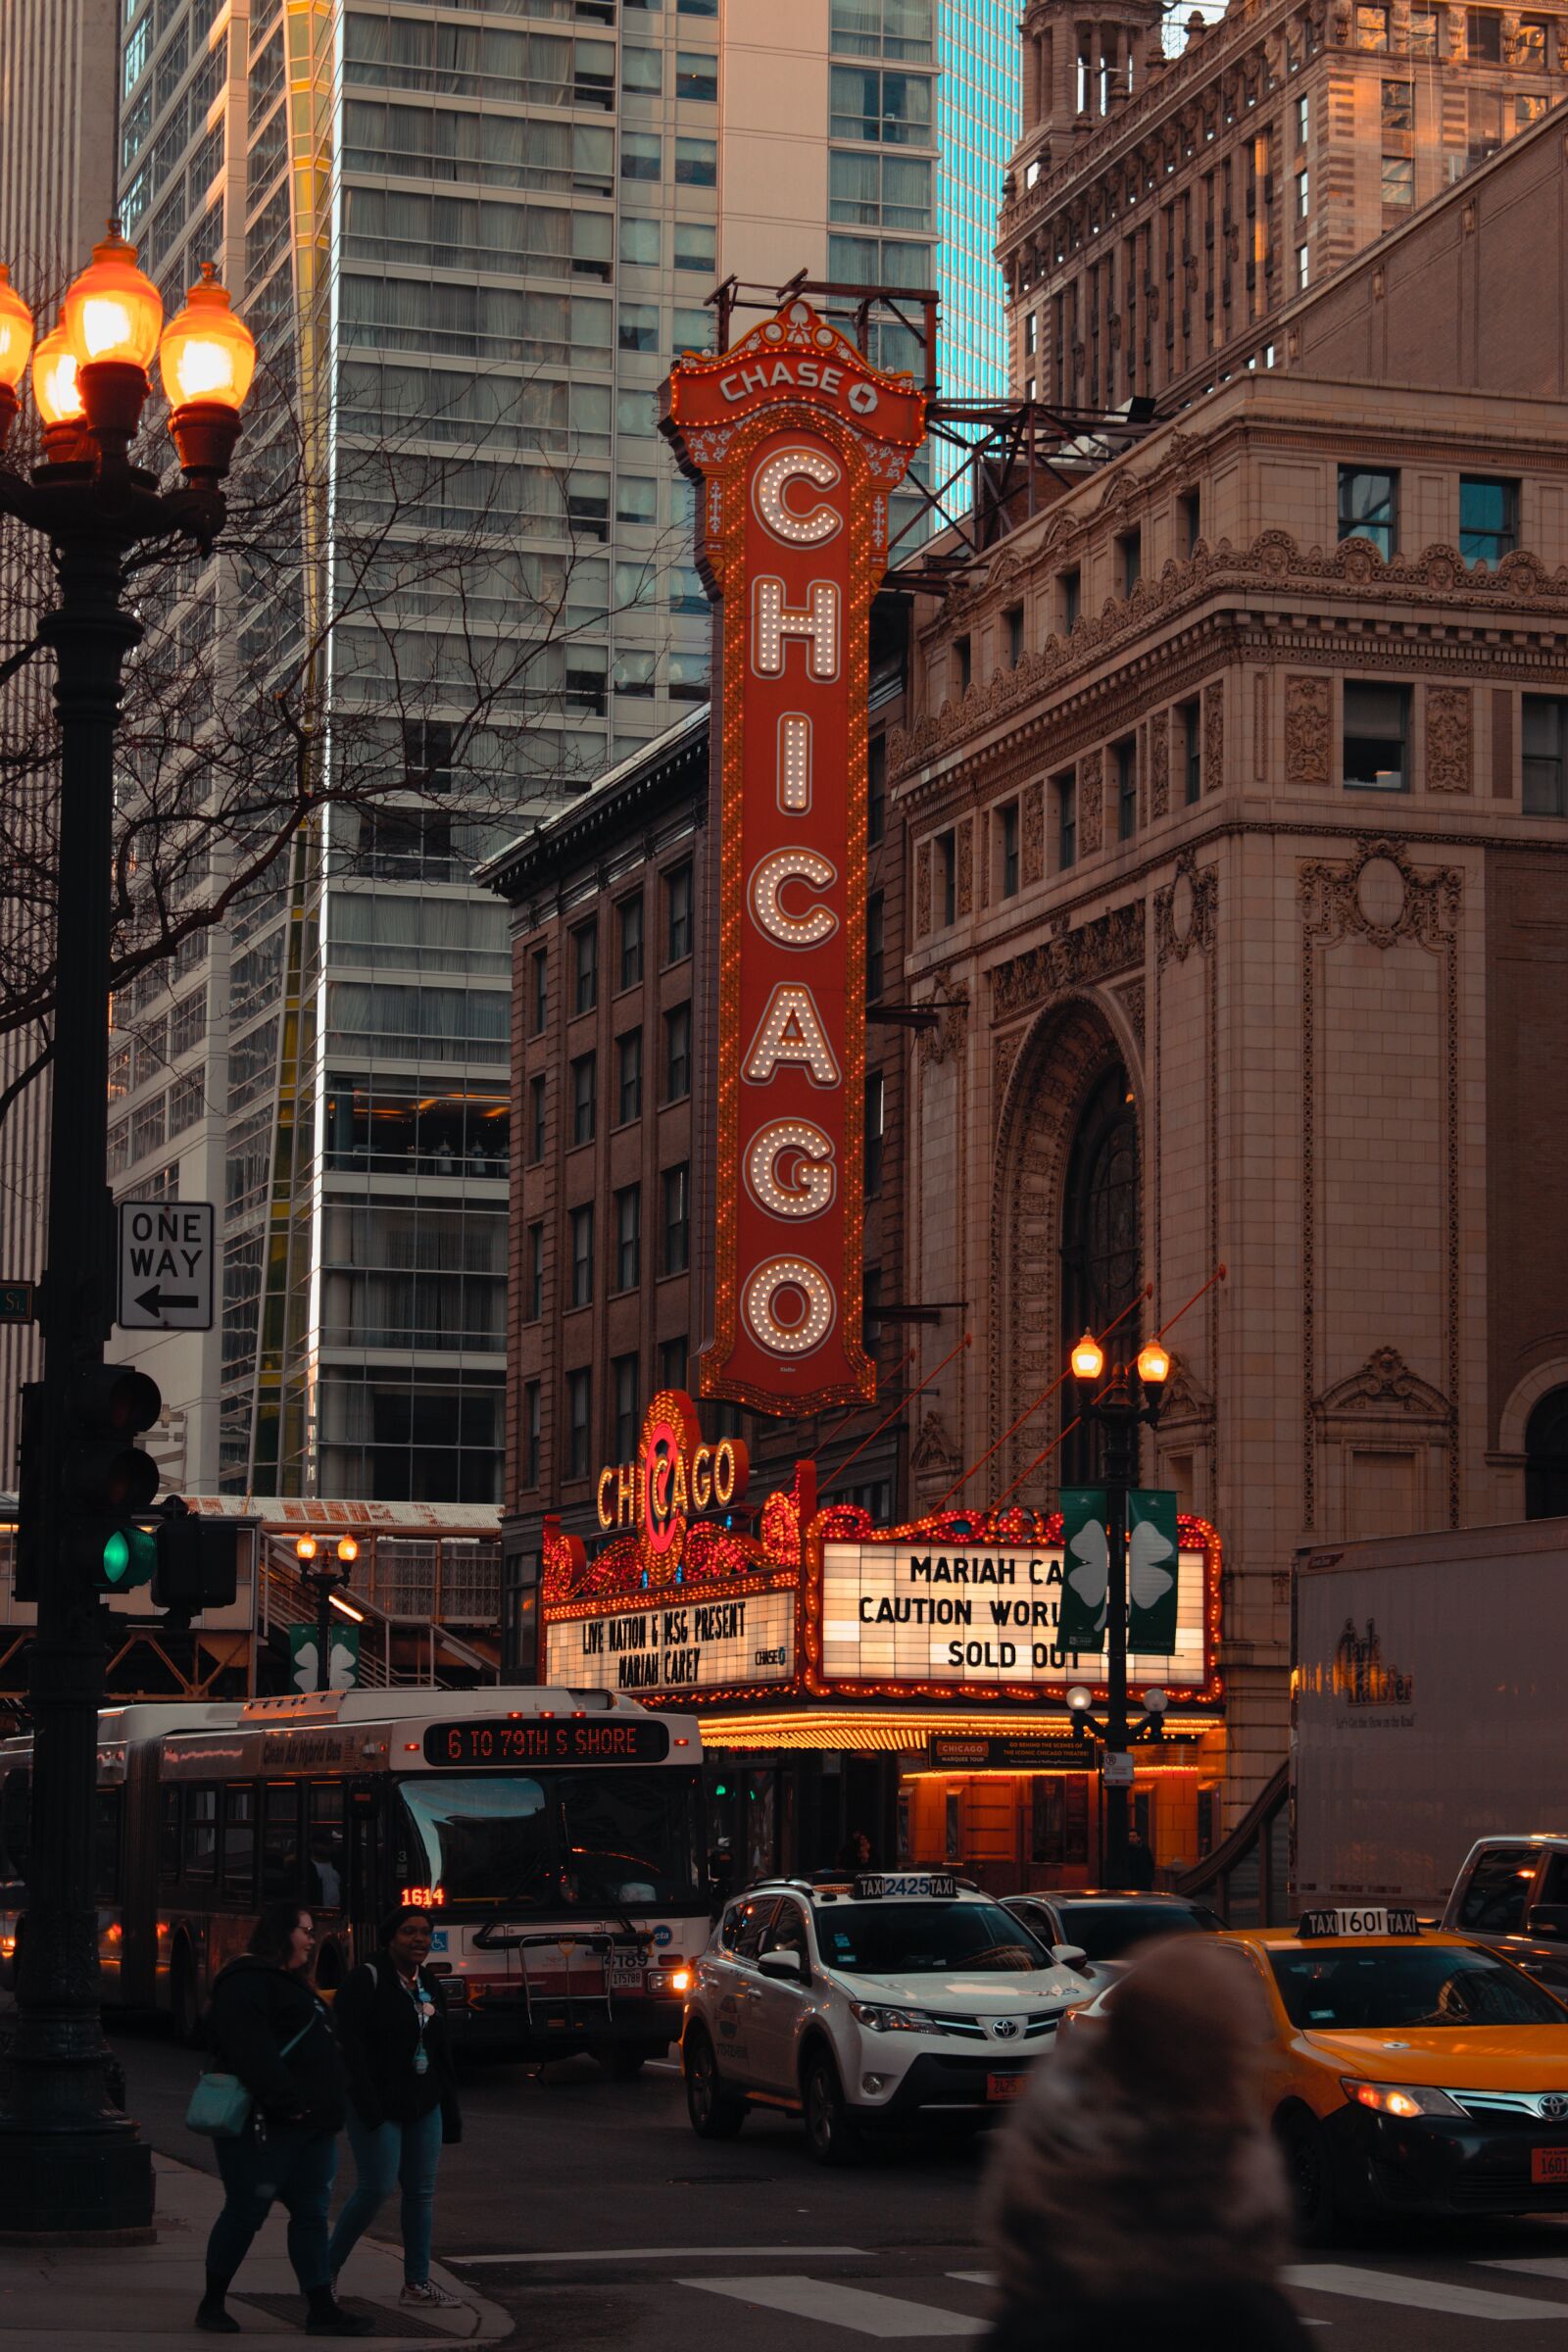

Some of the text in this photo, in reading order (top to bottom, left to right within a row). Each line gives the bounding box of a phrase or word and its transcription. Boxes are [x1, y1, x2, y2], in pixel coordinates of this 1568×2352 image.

[718, 360, 845, 402] CHASE
[739, 444, 843, 1361] CHICAGO
[132, 1212, 201, 1243] ONE
[130, 1249, 203, 1278] WAY
[597, 1437, 736, 1530] CHICAGO
[910, 1555, 1015, 1586] MARIAH
[858, 1596, 1060, 1627] CAUTION WORL
[582, 1601, 746, 1655] LIVE NATION & MSG PRESENT
[618, 1646, 701, 1688] MARIAH CAREY
[755, 1648, 778, 1666] CHASE
[947, 1640, 1016, 1669] SOLD
[264, 1738, 342, 1767] Clean Air Hybrid Bus
[446, 1727, 638, 1760] 6 TO 79TH S SHORE
[942, 1744, 983, 1753] CHICAGO
[401, 1887, 444, 1907] 1614
[860, 1877, 954, 1896] TAXI 2425 TAXI
[654, 1931, 669, 1940] cta
[1309, 1911, 1416, 1935] TAXI 1601 TAXI
